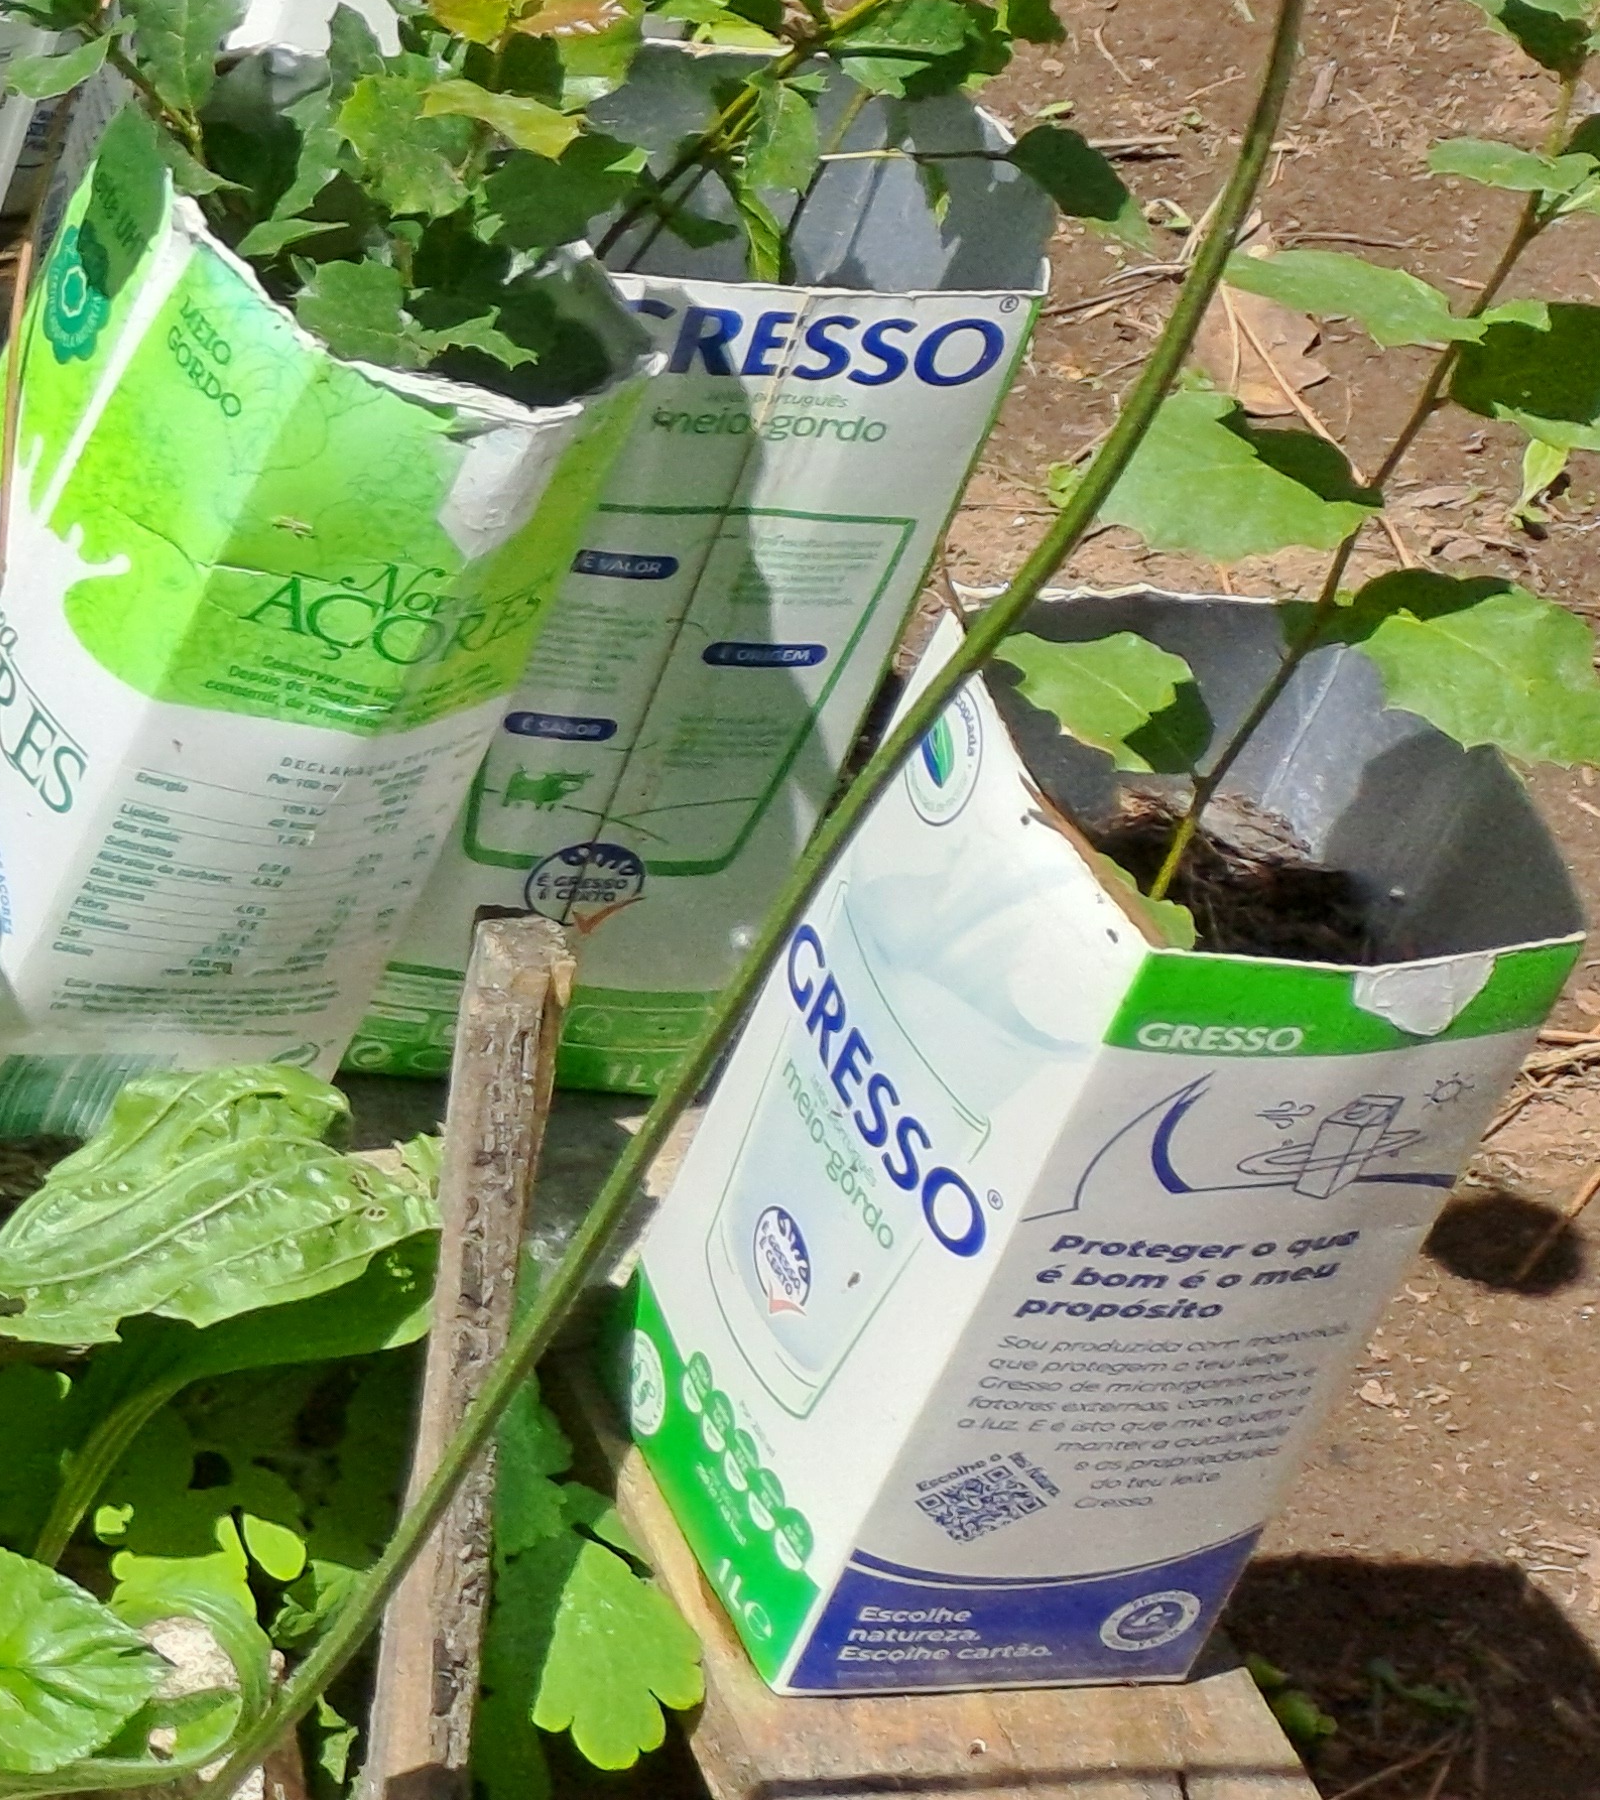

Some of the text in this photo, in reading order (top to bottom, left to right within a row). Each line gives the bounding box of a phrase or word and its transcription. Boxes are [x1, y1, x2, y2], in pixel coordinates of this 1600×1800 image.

[178, 296, 233, 367] MEIO
[659, 303, 1005, 389] RESSO
[166, 326, 243, 419] GORDO
[651, 405, 888, 443] meio-gordo
[1136, 1021, 1305, 1054] GRESSO
[787, 924, 988, 1257] GRESSO
[782, 1057, 894, 1252] meio-gordo
[1049, 1228, 1360, 1263] Proteger o que
[1034, 1259, 1340, 1290] é bom é o meu
[1013, 1294, 1224, 1323] propósito
[998, 1334, 1049, 1352] Sou
[988, 1355, 1038, 1372] que
[1041, 1356, 1168, 1377] protegem
[978, 1375, 1063, 1393] Gresso
[1069, 1379, 1099, 1394] de
[916, 1458, 988, 1493] Escolhe
[857, 1605, 972, 1624] Escolhe
[847, 1624, 981, 1644] natureza.
[836, 1640, 1053, 1663] Escolhe cartão.
